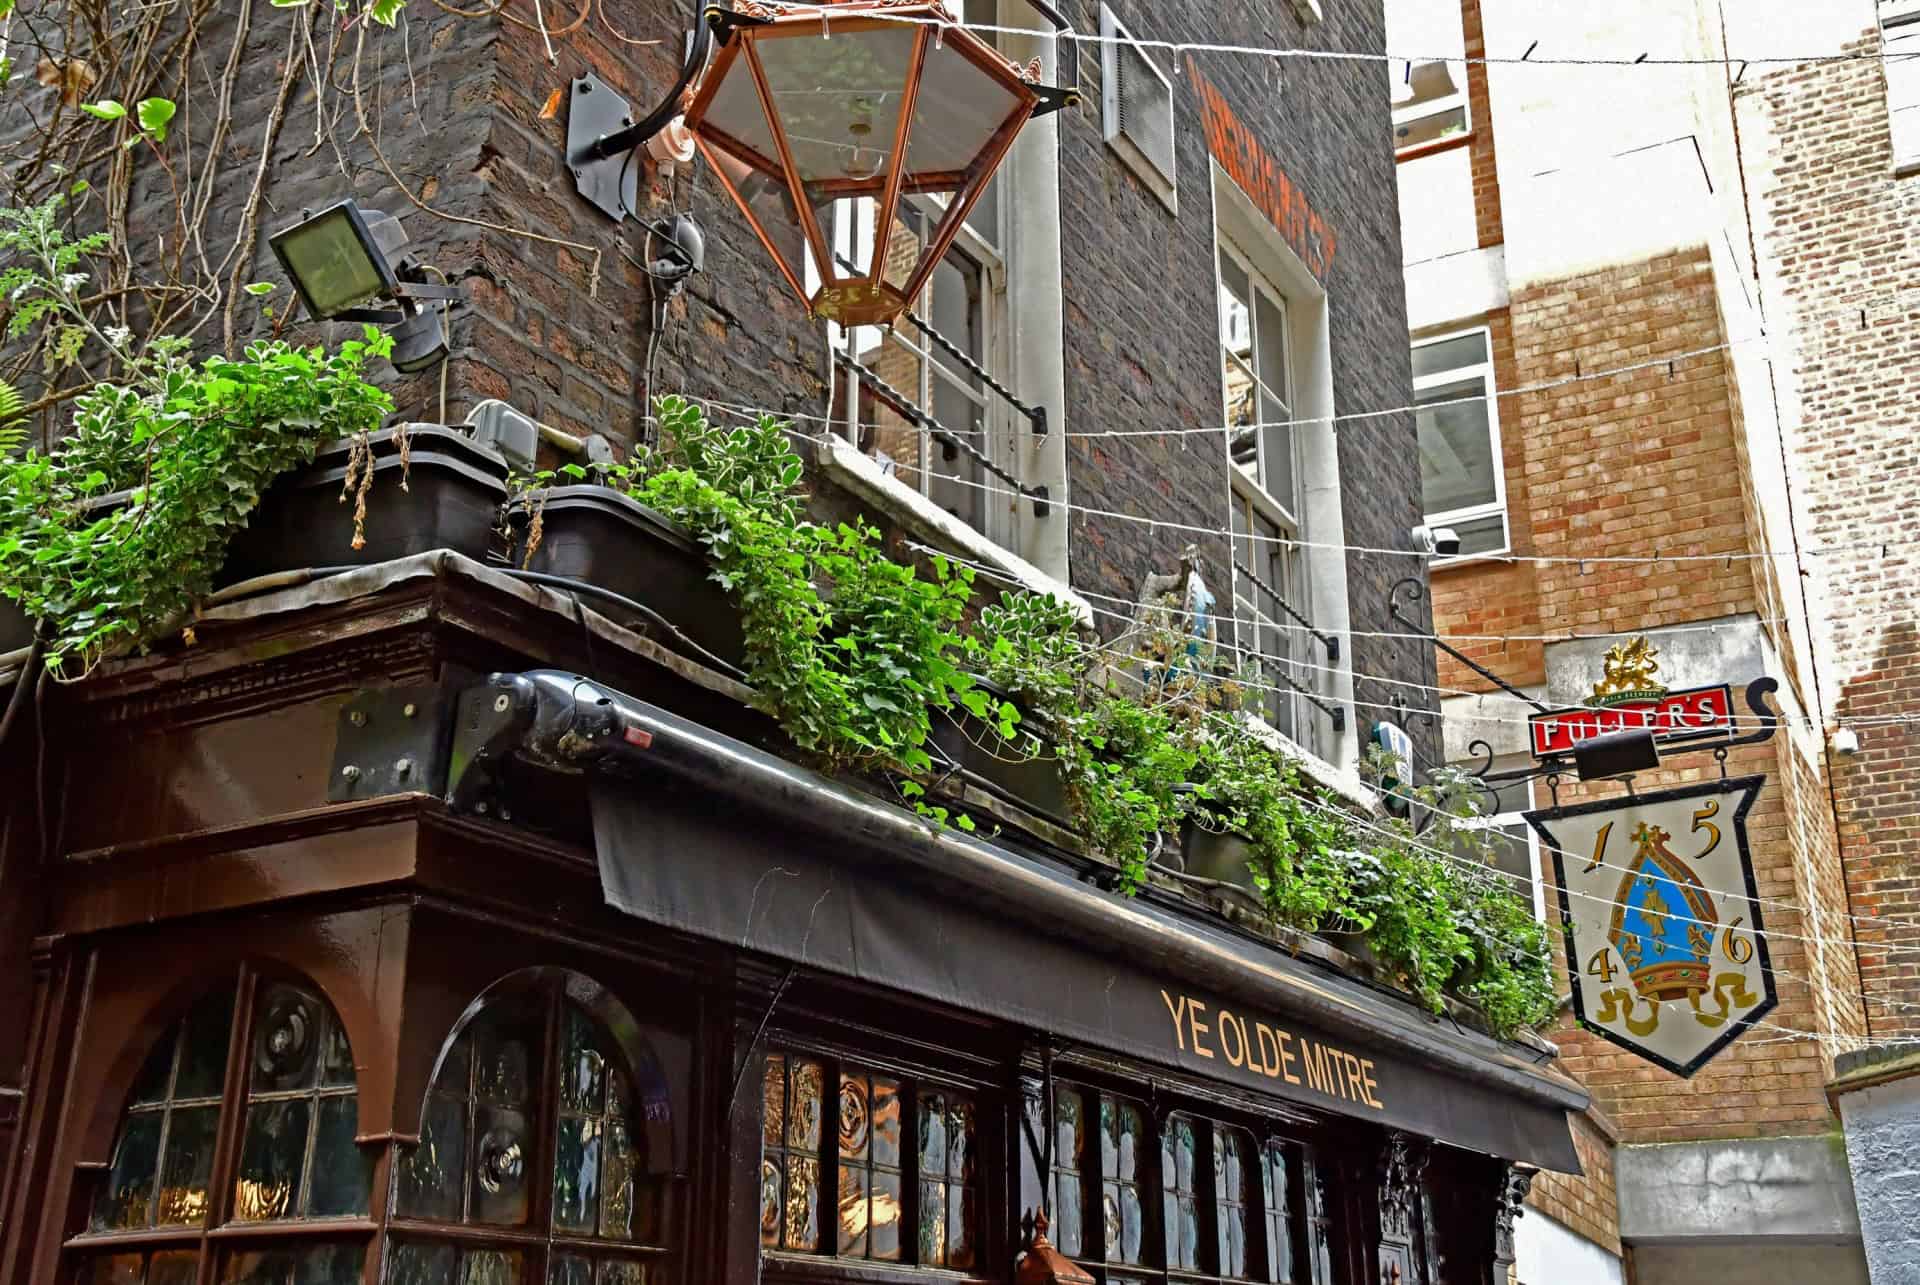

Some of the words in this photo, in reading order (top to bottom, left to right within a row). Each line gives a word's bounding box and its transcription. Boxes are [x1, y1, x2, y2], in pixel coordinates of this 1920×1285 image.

[1543, 696, 1716, 746] FULLER'S
[1583, 821, 1614, 874] 1
[1691, 799, 1721, 860] 5
[1588, 947, 1618, 984] 4
[1722, 915, 1753, 965] 6
[1161, 989, 1214, 1059] YE
[1218, 1009, 1301, 1085] OLDE
[1300, 1037, 1384, 1110] MITRE
